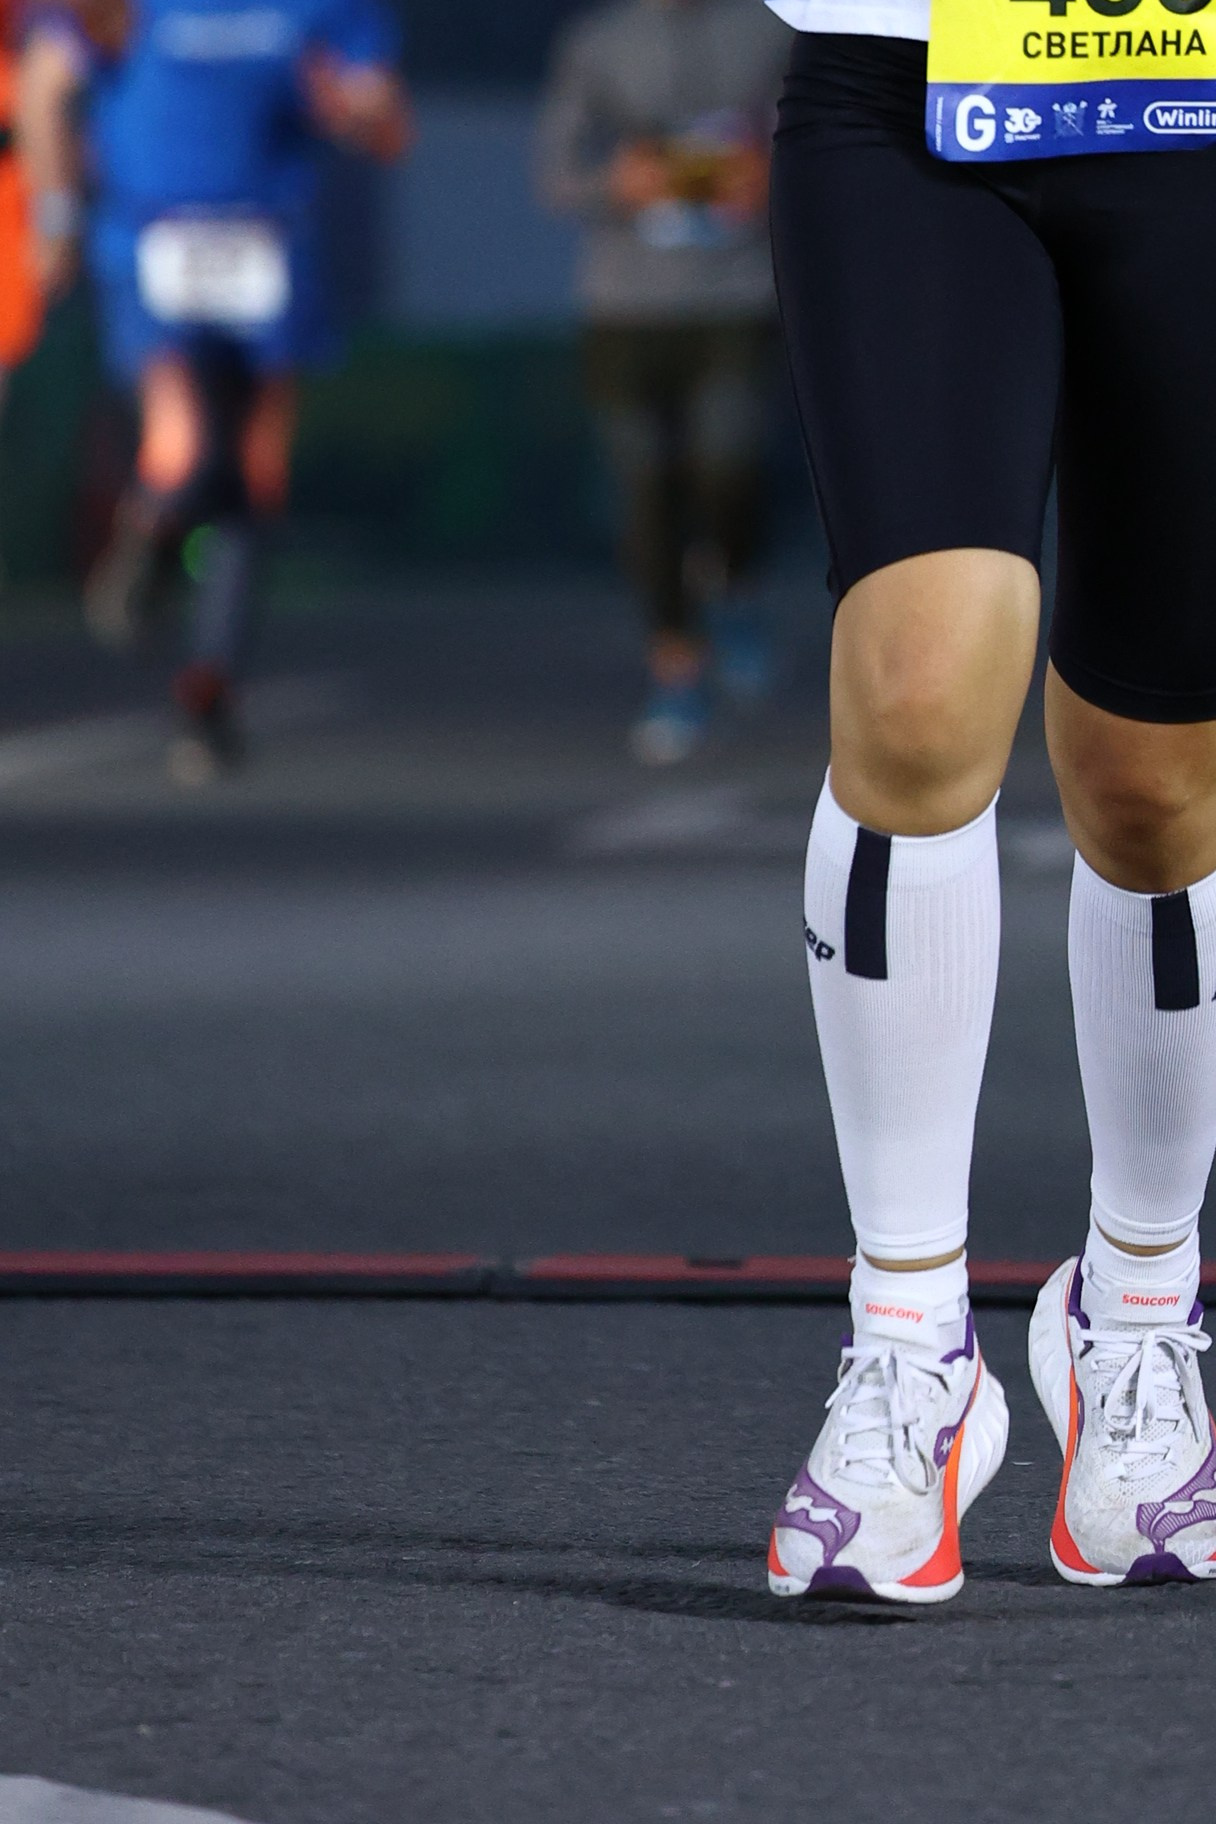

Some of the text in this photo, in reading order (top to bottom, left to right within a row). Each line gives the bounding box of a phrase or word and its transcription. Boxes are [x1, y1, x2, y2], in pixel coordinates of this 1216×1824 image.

[1022, 29, 1207, 59] СВЕТЛАНА
[955, 94, 996, 152] G
[865, 1302, 924, 1323] saucony
[1122, 1293, 1181, 1308] saucony
